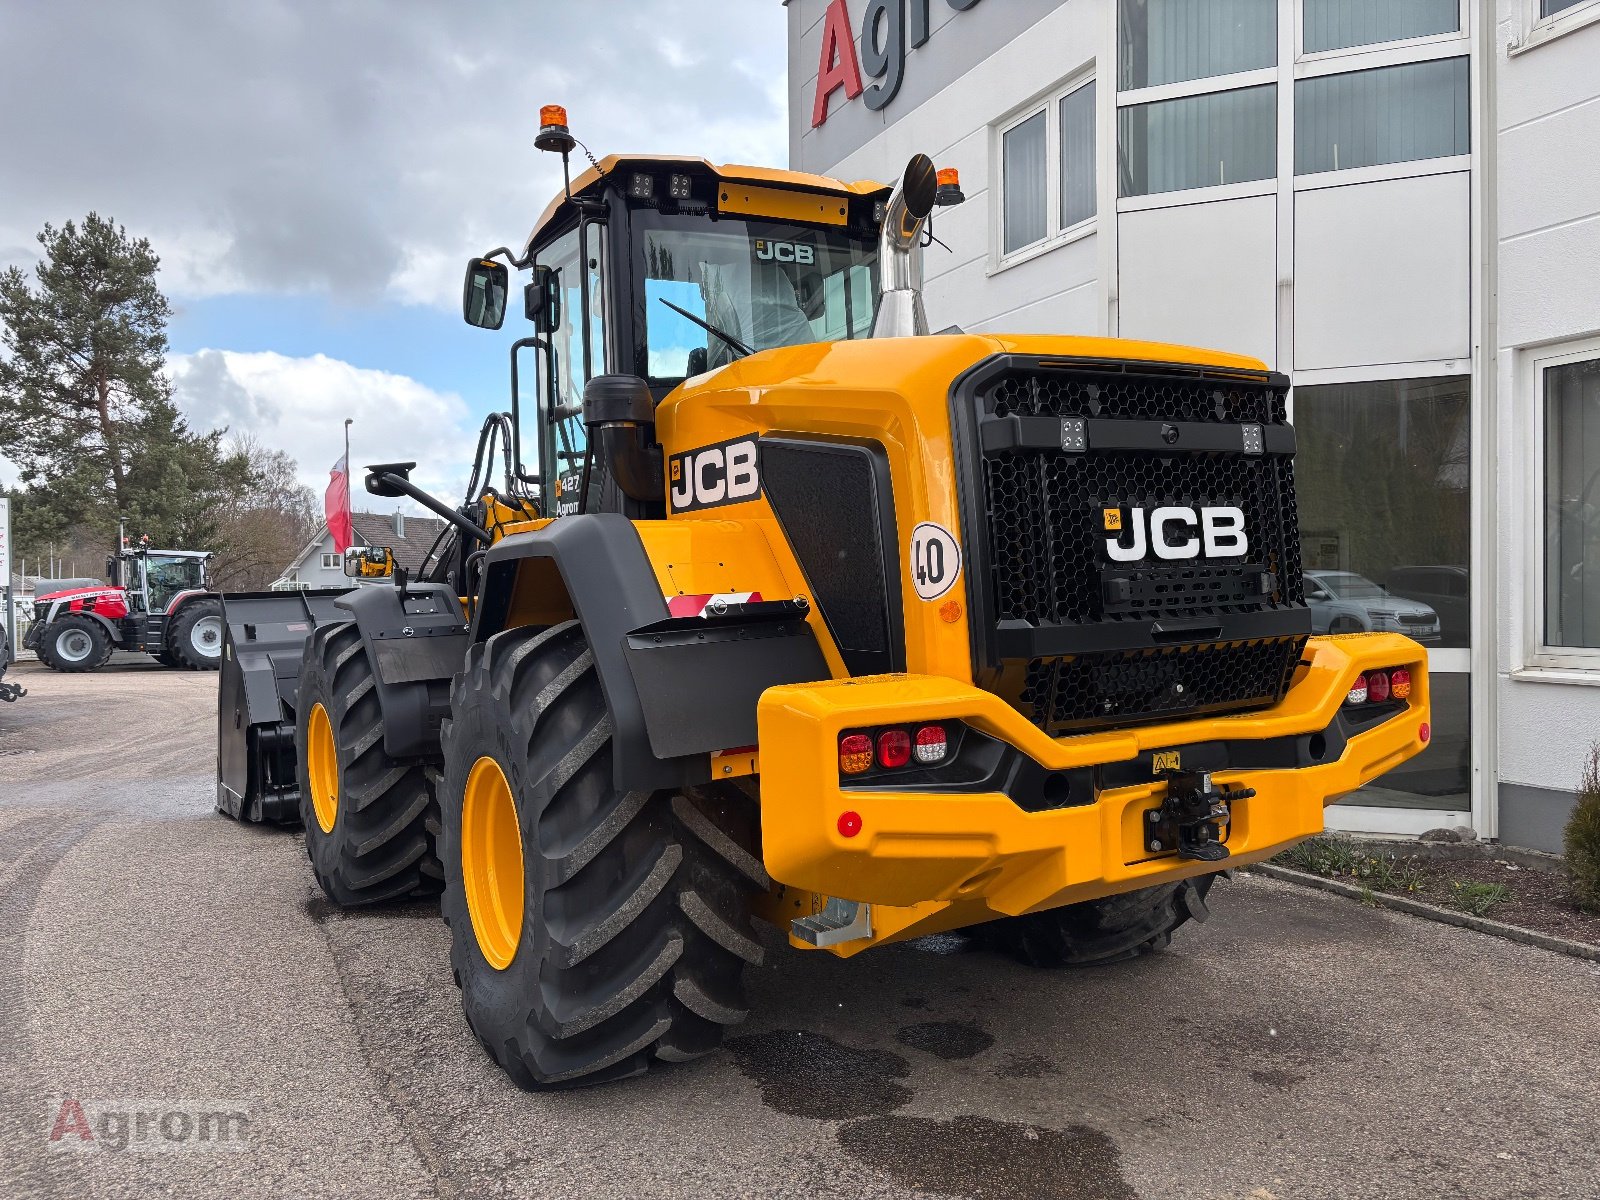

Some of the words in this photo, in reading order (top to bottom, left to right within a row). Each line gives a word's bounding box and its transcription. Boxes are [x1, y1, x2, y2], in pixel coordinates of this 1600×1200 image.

[757, 242, 814, 264] JCB
[562, 475, 580, 491] 427
[672, 441, 759, 508] JCB
[1106, 507, 1249, 562] JCB
[915, 538, 945, 587] 40
